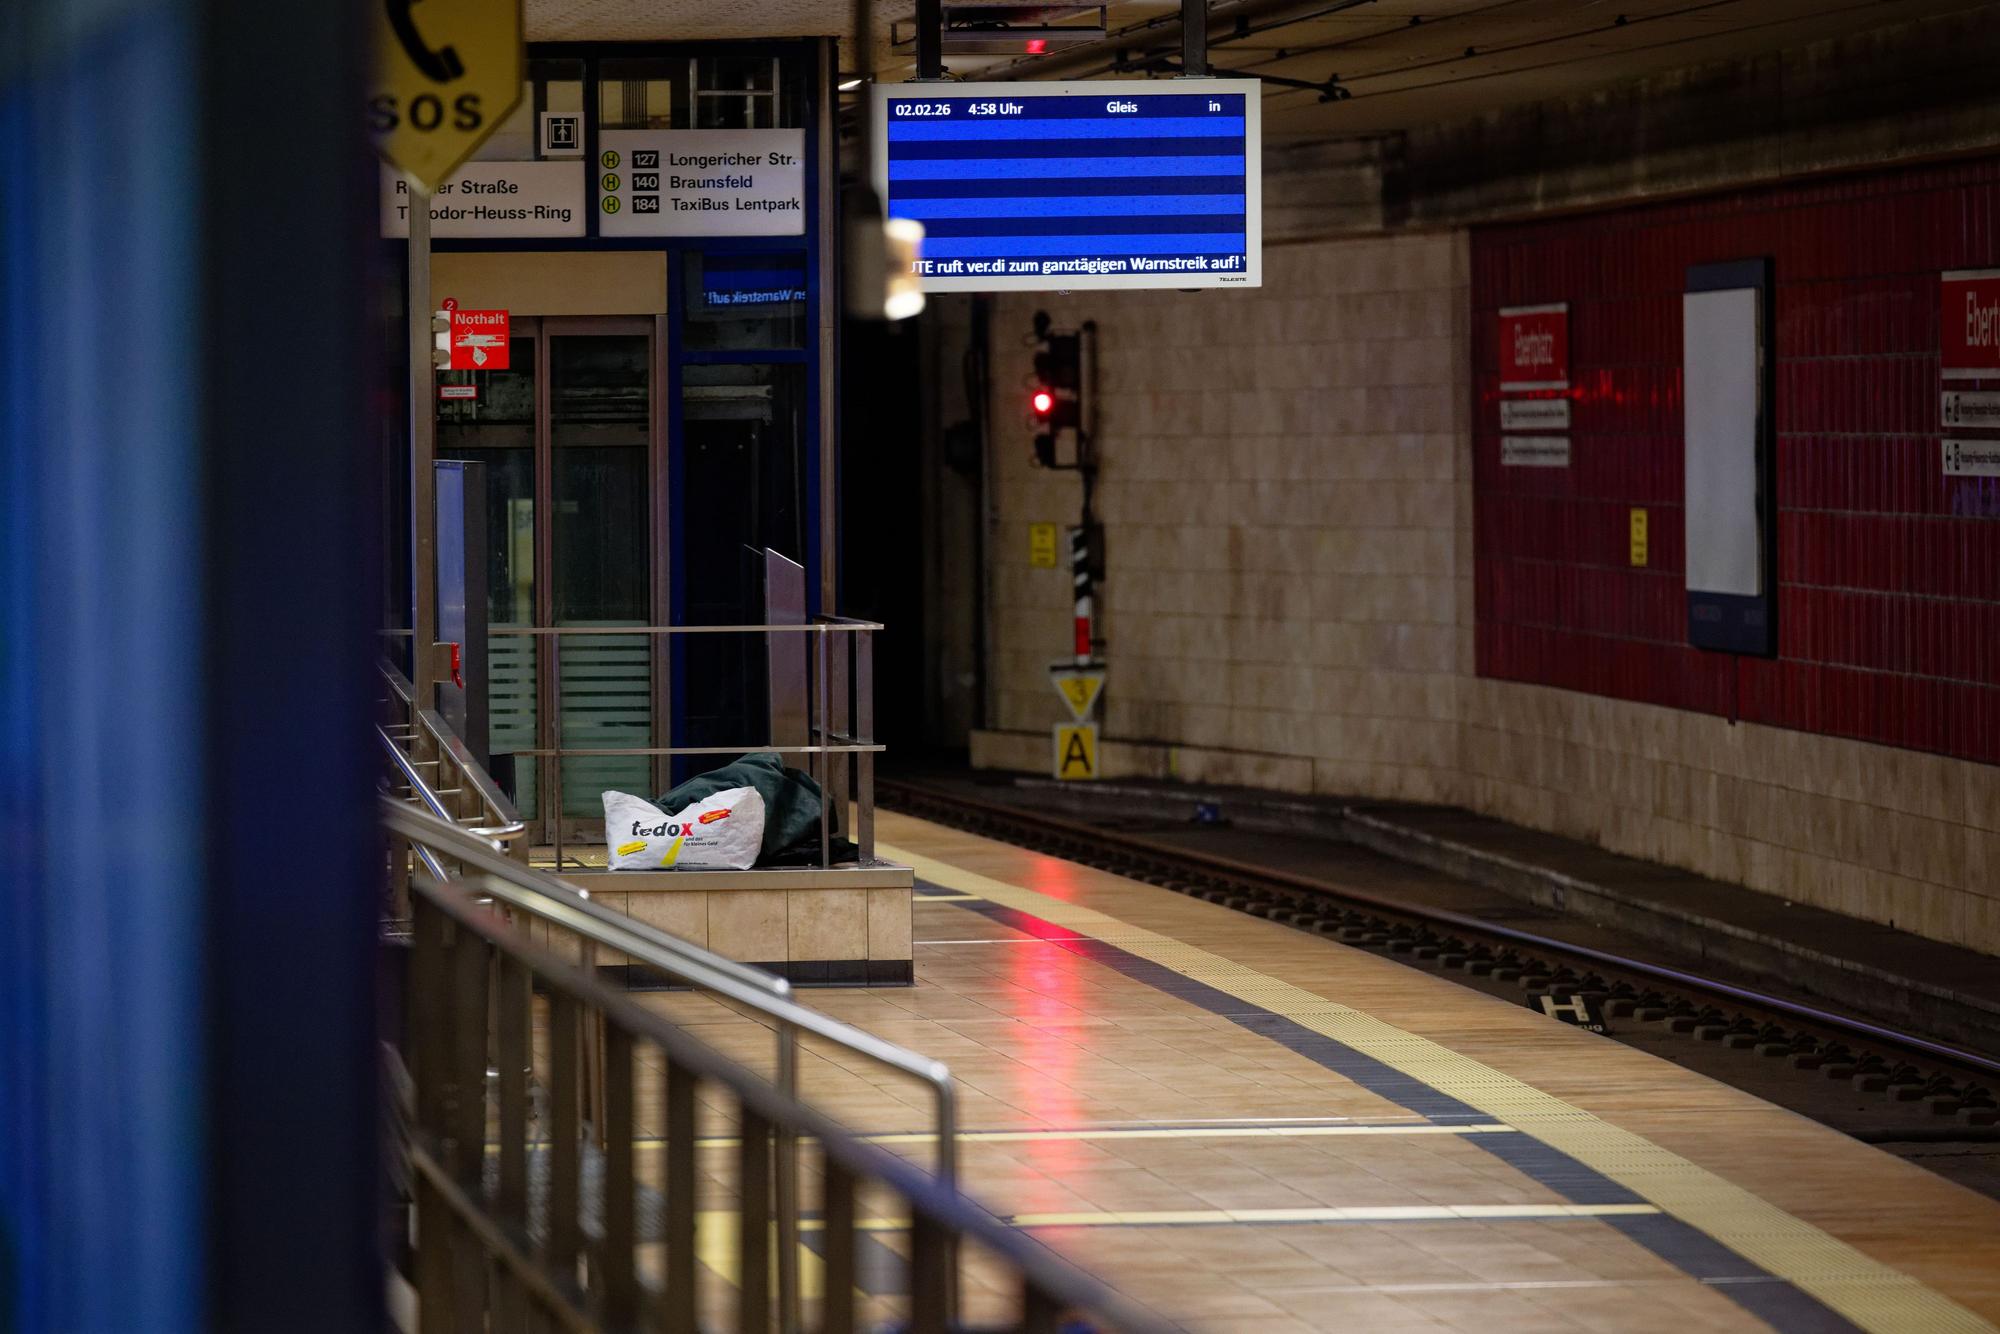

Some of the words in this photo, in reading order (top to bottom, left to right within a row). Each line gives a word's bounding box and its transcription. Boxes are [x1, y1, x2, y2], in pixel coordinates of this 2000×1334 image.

[368, 93, 482, 132] SOS
[895, 104, 951, 116] 02.02.26
[968, 103, 997, 115] 4:58
[1000, 102, 1024, 115] Uhr
[1106, 101, 1138, 113] Gleis
[1208, 100, 1221, 112] in
[634, 154, 657, 165] 127
[670, 152, 762, 169] Longericher
[769, 152, 797, 165] Str.
[461, 180, 519, 194] Straße
[634, 177, 658, 188] 140
[670, 175, 753, 189] Braunsfeld
[634, 199, 658, 210] 184
[671, 198, 729, 211] TaxiBus
[736, 198, 800, 213] Lentpark
[397, 205, 572, 222] Todor-Heuss-Ring
[937, 259, 964, 273] ruft
[967, 259, 1005, 273] ver.di
[1009, 261, 1038, 272] zum
[1042, 257, 1126, 274] ganztägigen
[1130, 256, 1208, 271] Warnstreik
[1211, 255, 1239, 269] auf!
[446, 300, 454, 310] 2
[455, 313, 504, 325] Nothalt
[1966, 291, 2000, 359] Ebert
[1061, 731, 1092, 774] A
[631, 820, 694, 837] tedox
